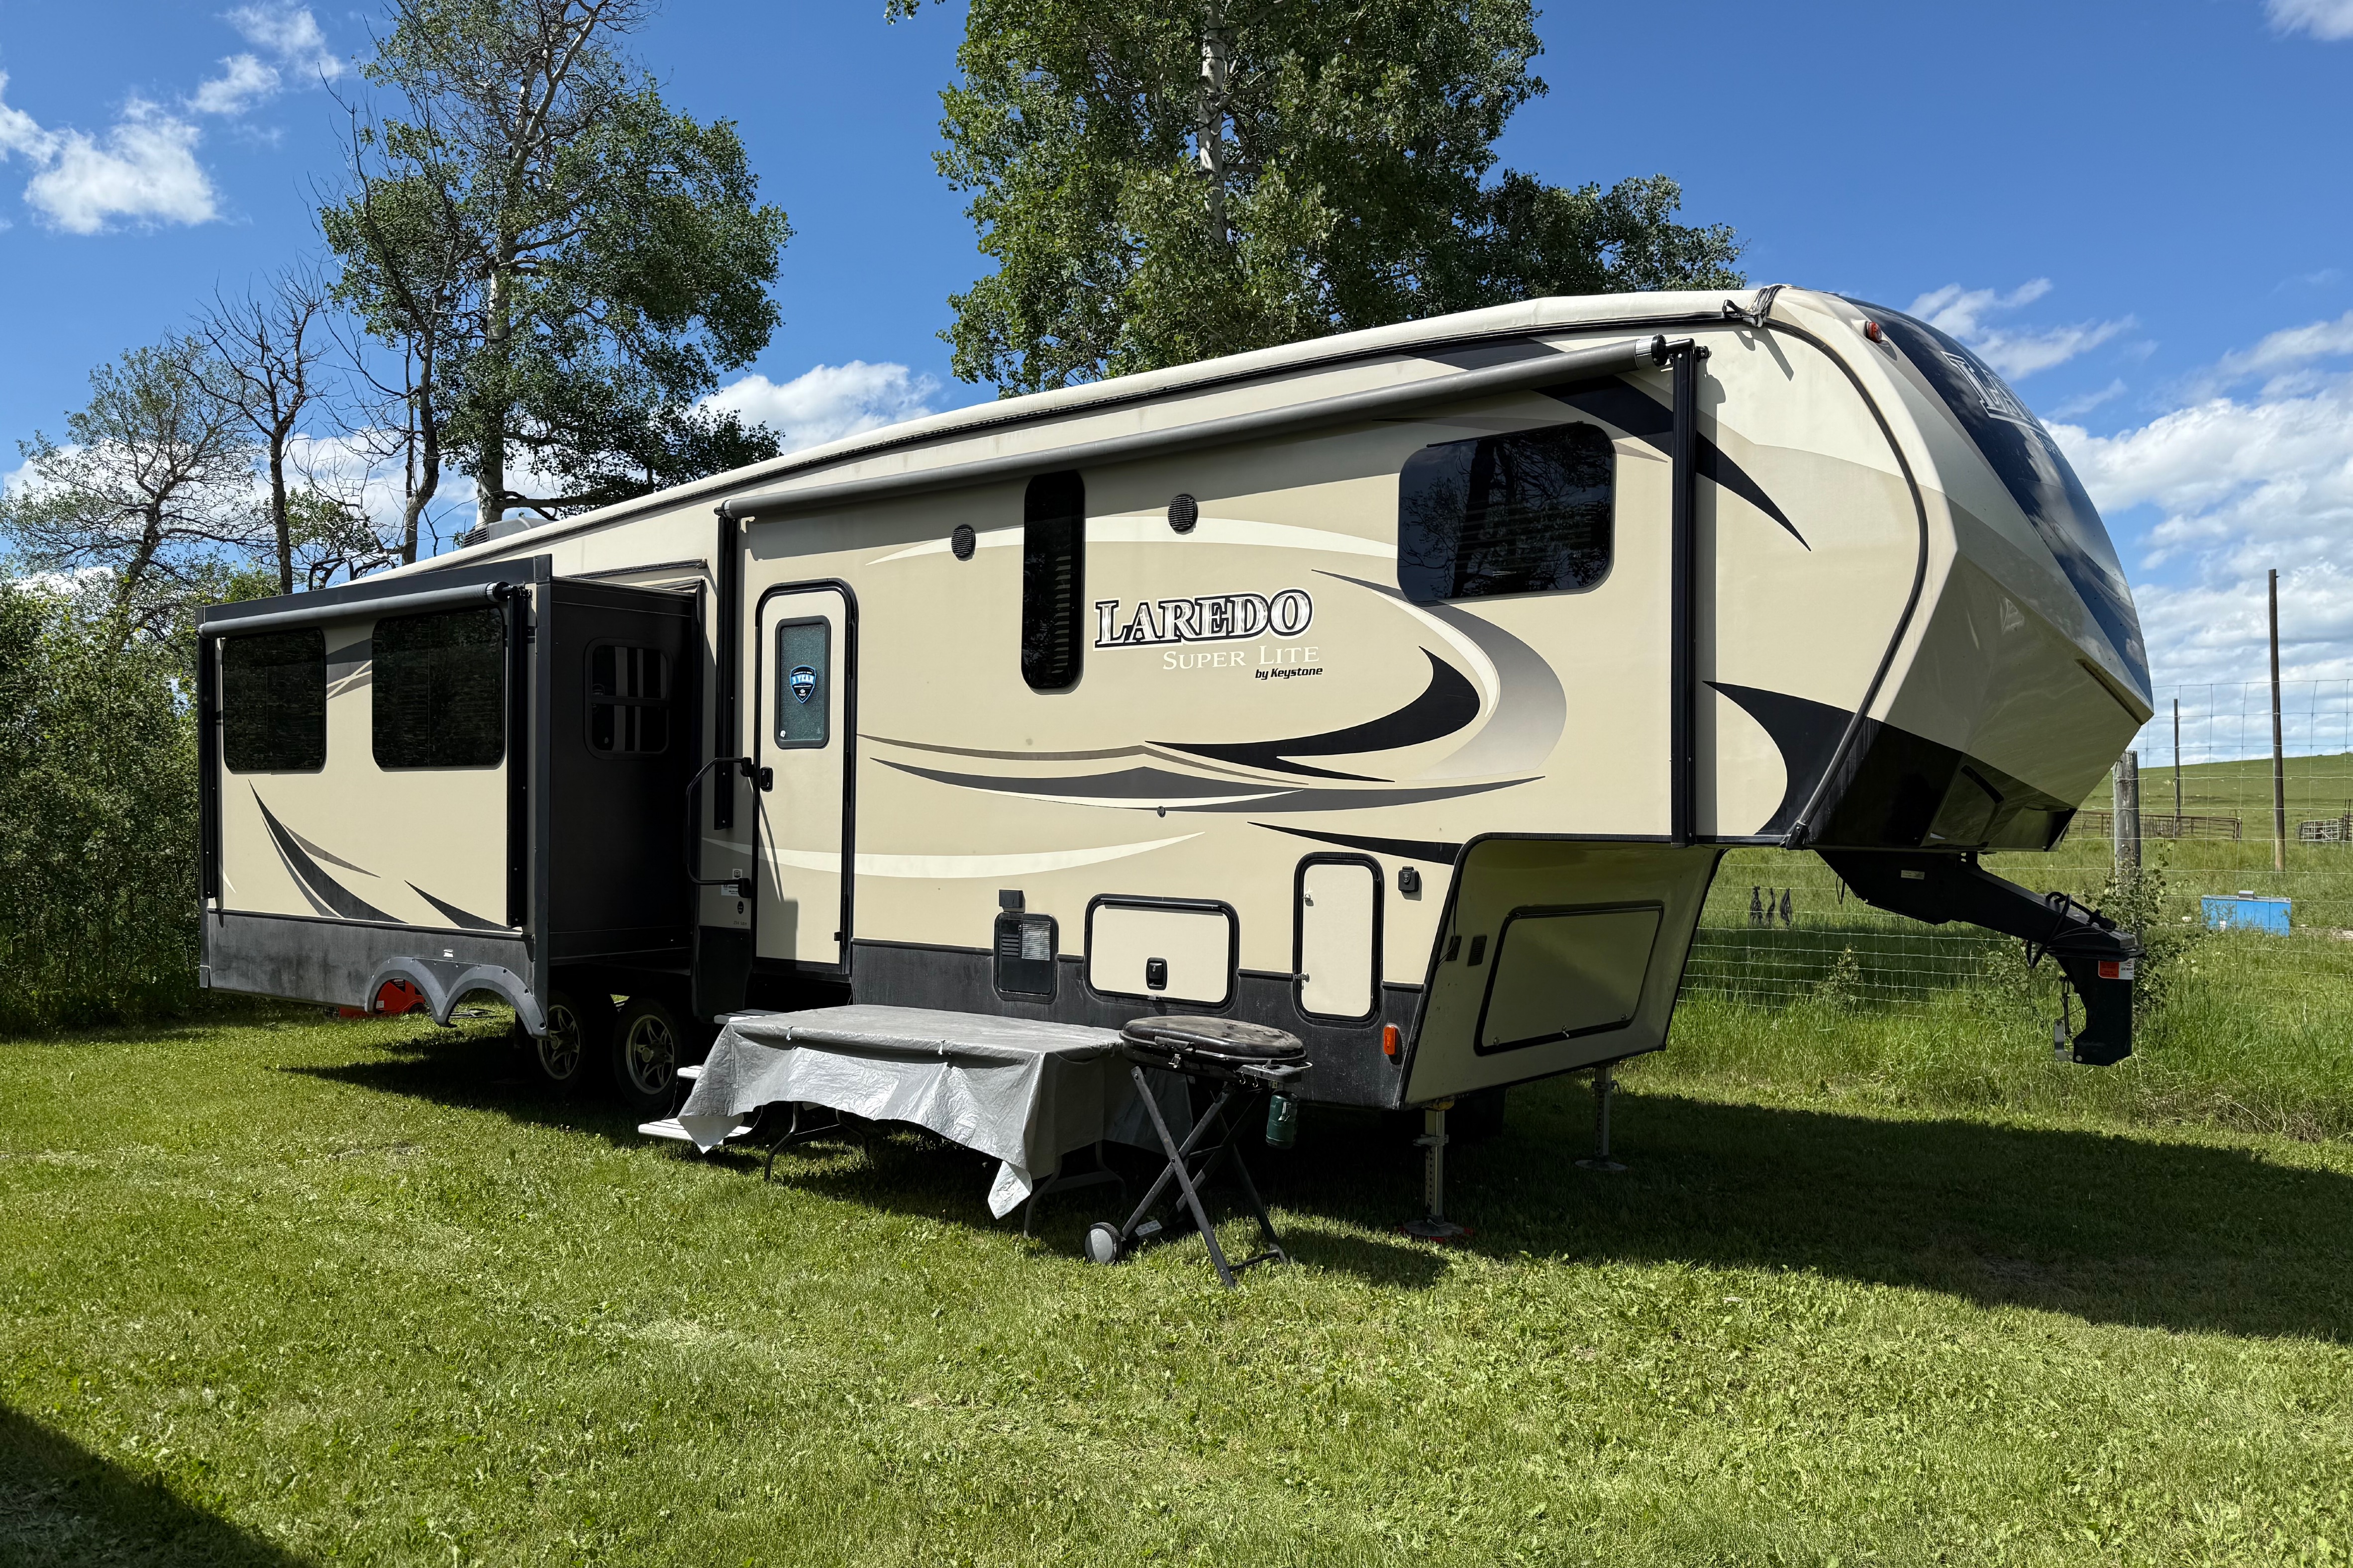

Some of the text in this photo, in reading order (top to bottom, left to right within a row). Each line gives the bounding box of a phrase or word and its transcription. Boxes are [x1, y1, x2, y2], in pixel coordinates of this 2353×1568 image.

[1094, 588, 1314, 650] LAREDO
[1163, 645, 1320, 670] SUPER LITE
[797, 674, 814, 684] YEAR
[1255, 667, 1323, 681] by Keystone
